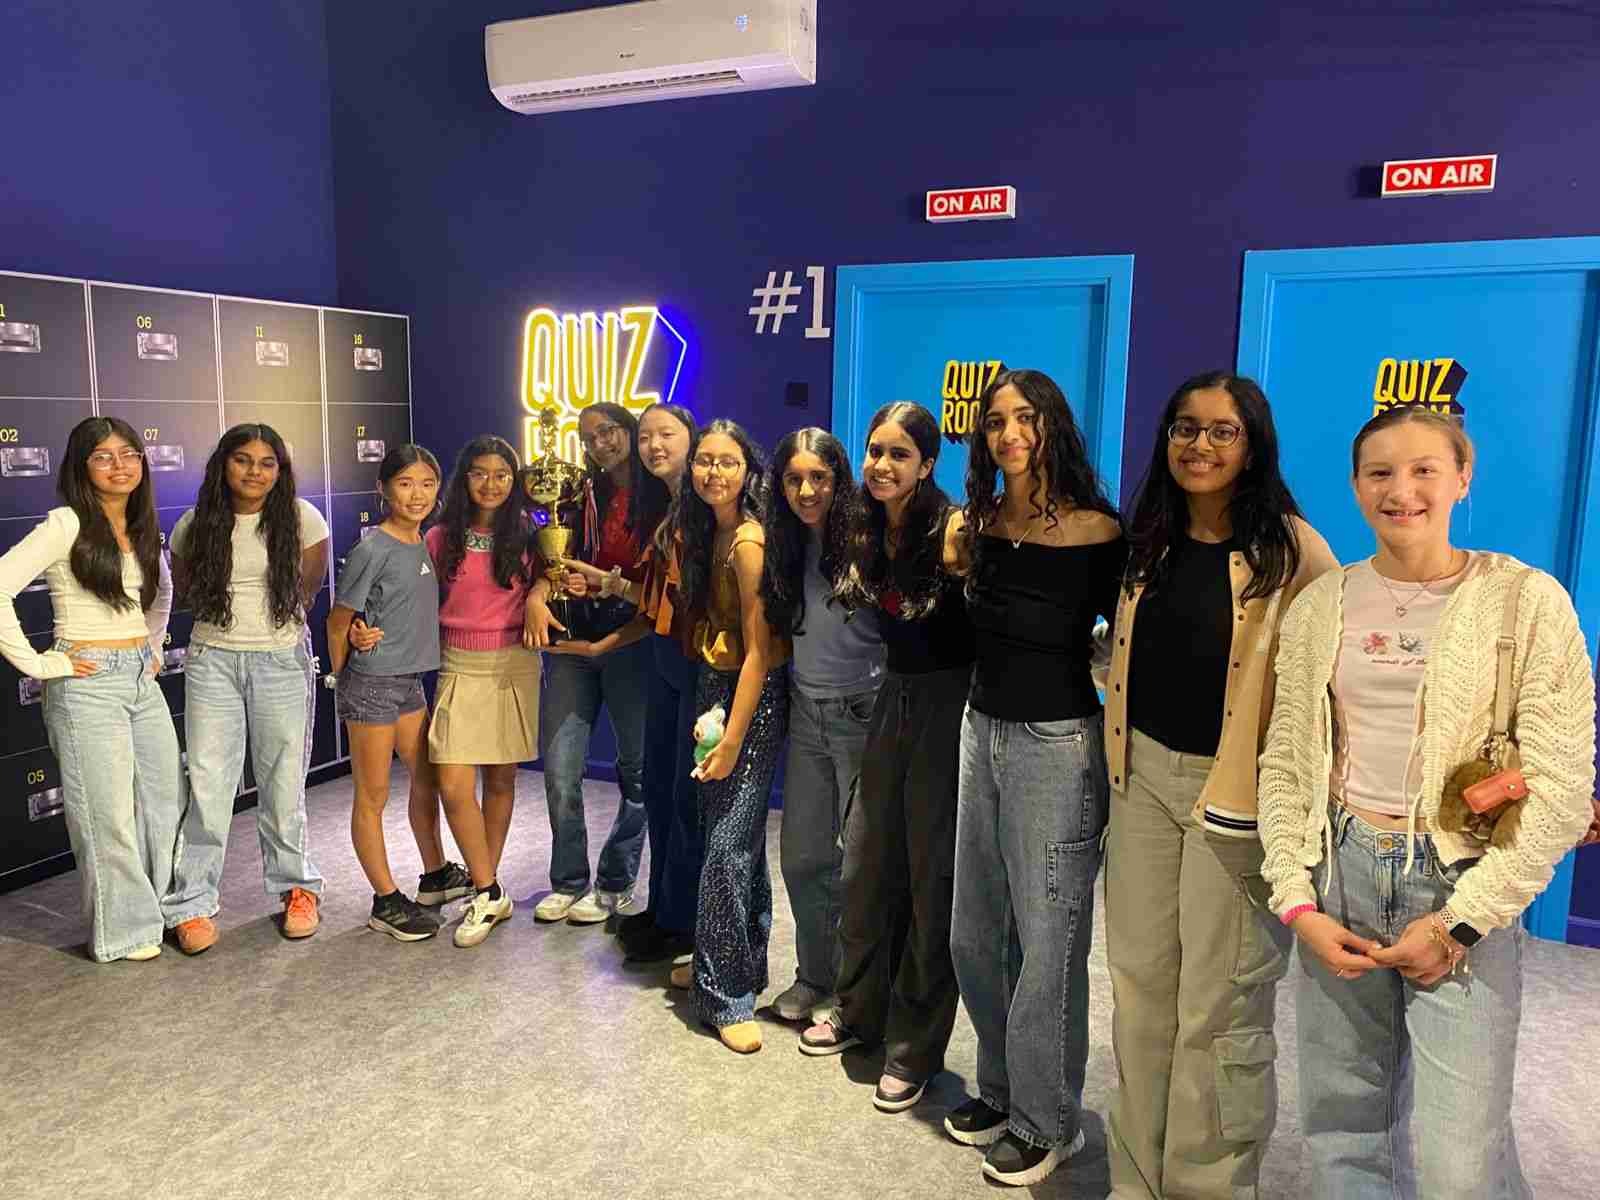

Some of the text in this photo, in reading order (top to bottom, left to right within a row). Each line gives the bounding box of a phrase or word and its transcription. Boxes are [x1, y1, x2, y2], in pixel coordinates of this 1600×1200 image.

[1391, 163, 1485, 188] ON AIR
[933, 192, 1002, 213] ON AIR
[749, 266, 831, 338] #1
[136, 315, 152, 329] 06
[521, 307, 660, 418] QUIZ
[942, 359, 1001, 401] QUIZ
[1373, 358, 1454, 404] QUIZ
[0, 428, 18, 442] 02
[143, 428, 159, 441] 07
[27, 769, 45, 785] 05
